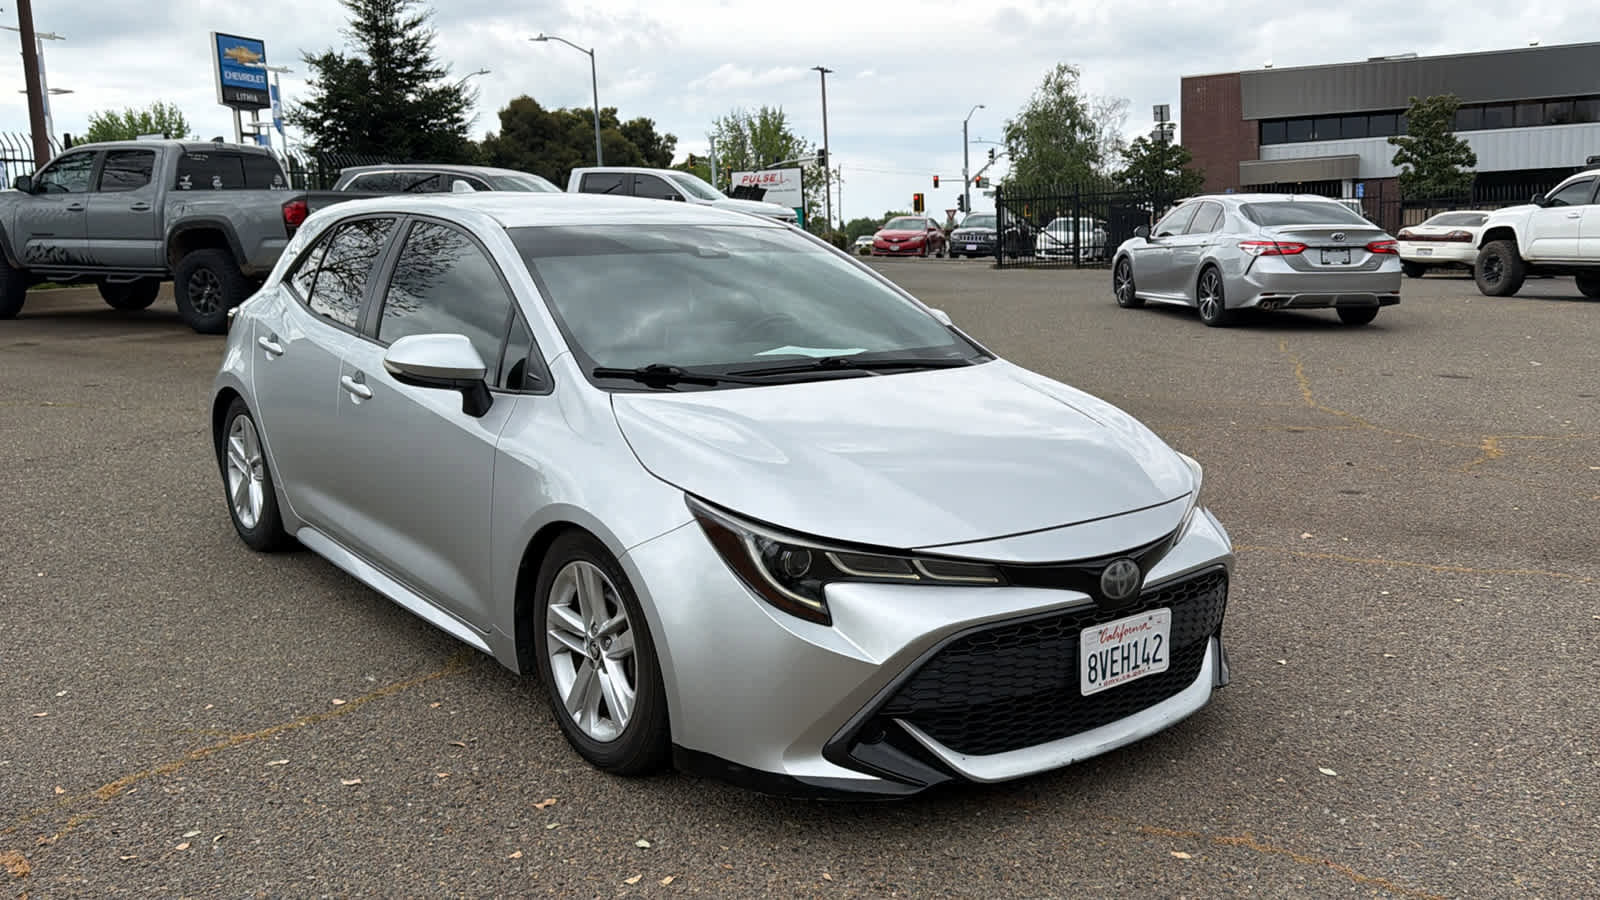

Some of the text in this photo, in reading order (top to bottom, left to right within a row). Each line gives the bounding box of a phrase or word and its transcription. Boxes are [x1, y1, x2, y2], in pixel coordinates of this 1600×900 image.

[224, 70, 265, 83] CHEVROLET
[235, 92, 259, 103] LITHIA
[741, 173, 777, 185] PULSE
[1100, 622, 1152, 644] California
[1088, 633, 1163, 684] 8VEH142
